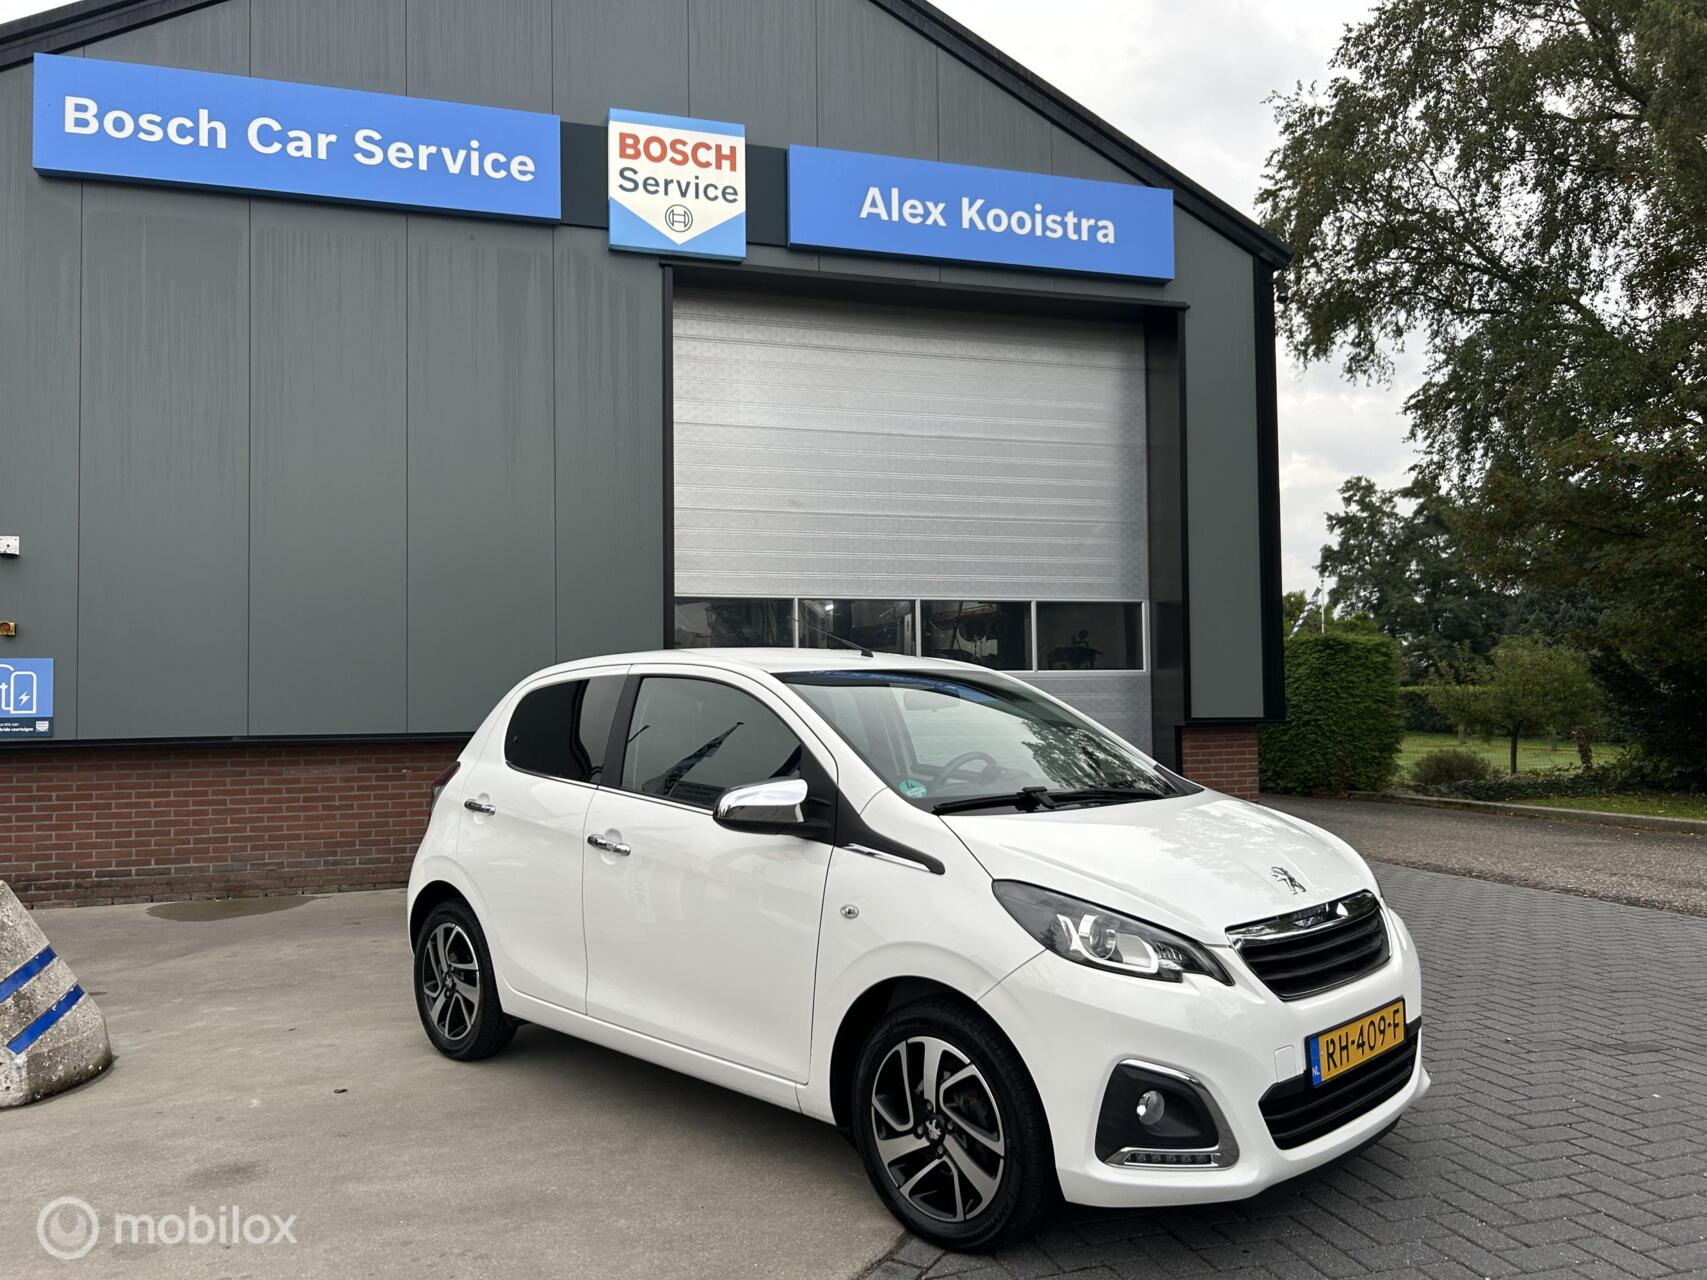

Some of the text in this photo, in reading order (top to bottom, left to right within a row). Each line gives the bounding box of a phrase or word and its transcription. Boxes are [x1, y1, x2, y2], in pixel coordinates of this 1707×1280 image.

[64, 95, 536, 183] Bosch Car Service
[618, 131, 737, 173] BOSCH
[618, 166, 739, 204] Service
[859, 186, 1116, 244] Alex Kooistra
[1325, 1008, 1400, 1072] RH-409-F
